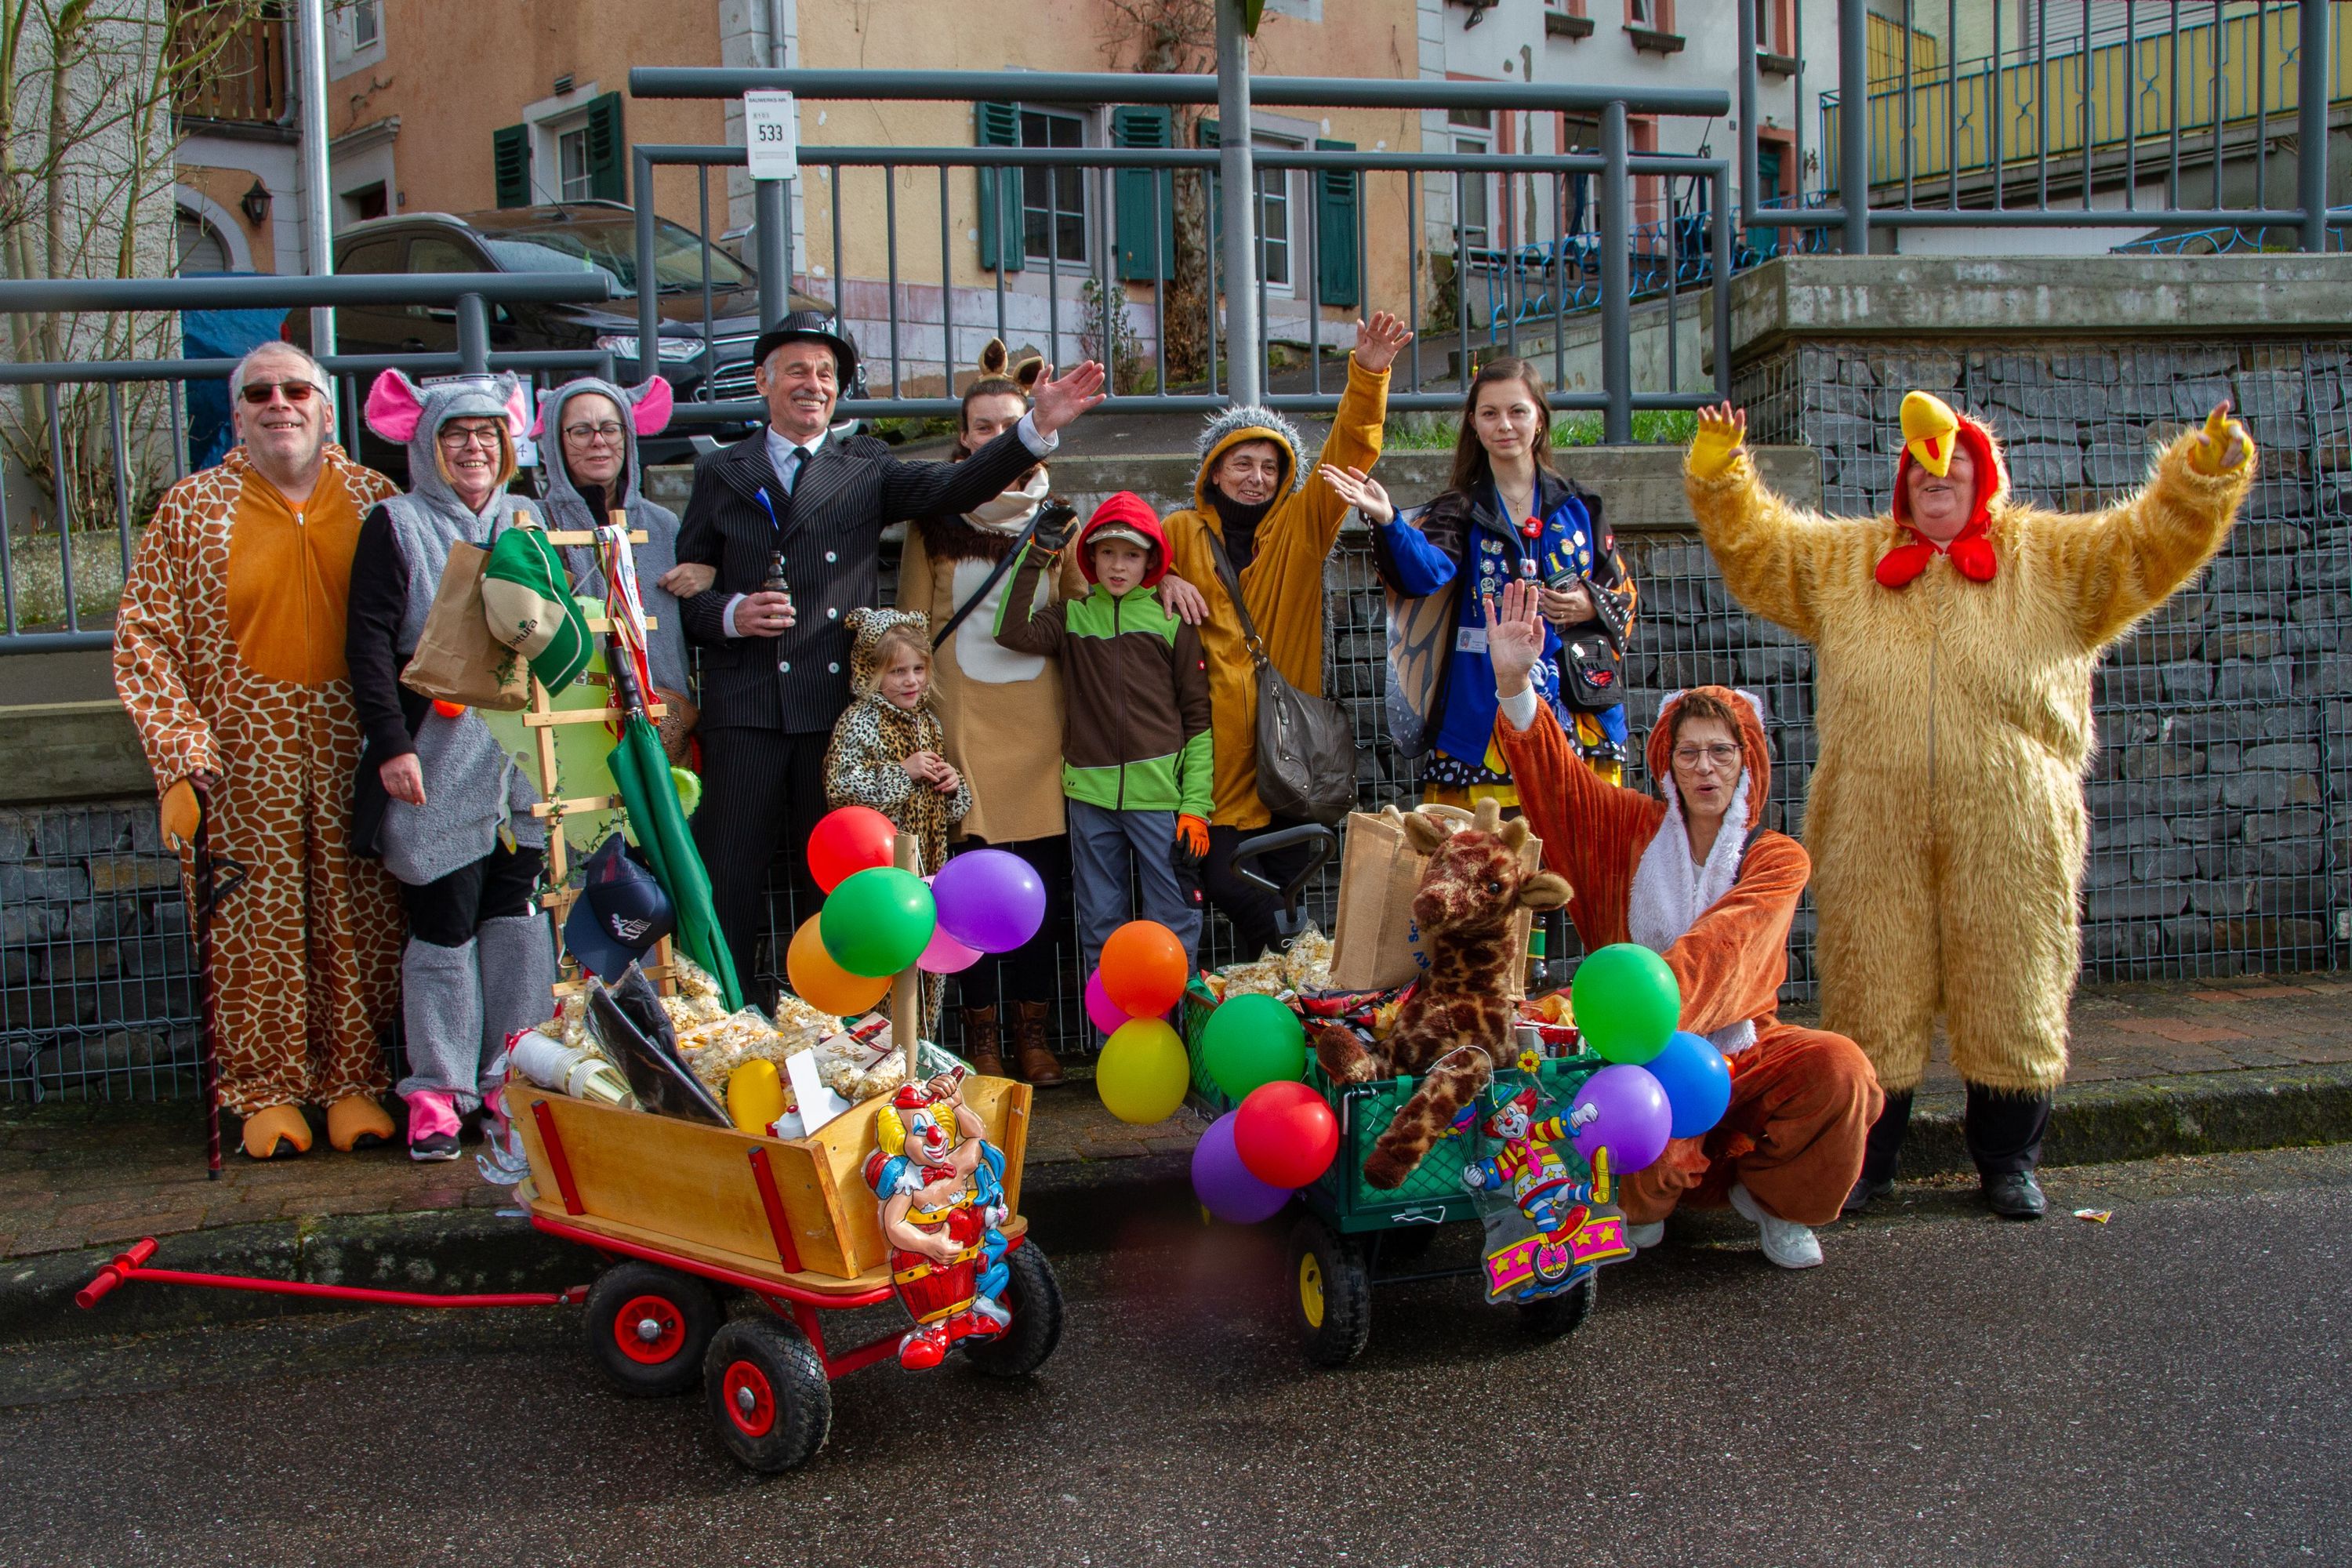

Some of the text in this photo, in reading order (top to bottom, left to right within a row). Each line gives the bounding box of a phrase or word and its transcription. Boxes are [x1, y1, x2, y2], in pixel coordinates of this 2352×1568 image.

[759, 125, 782, 142] 533
[517, 444, 528, 458] 4
[507, 619, 538, 648] patura
